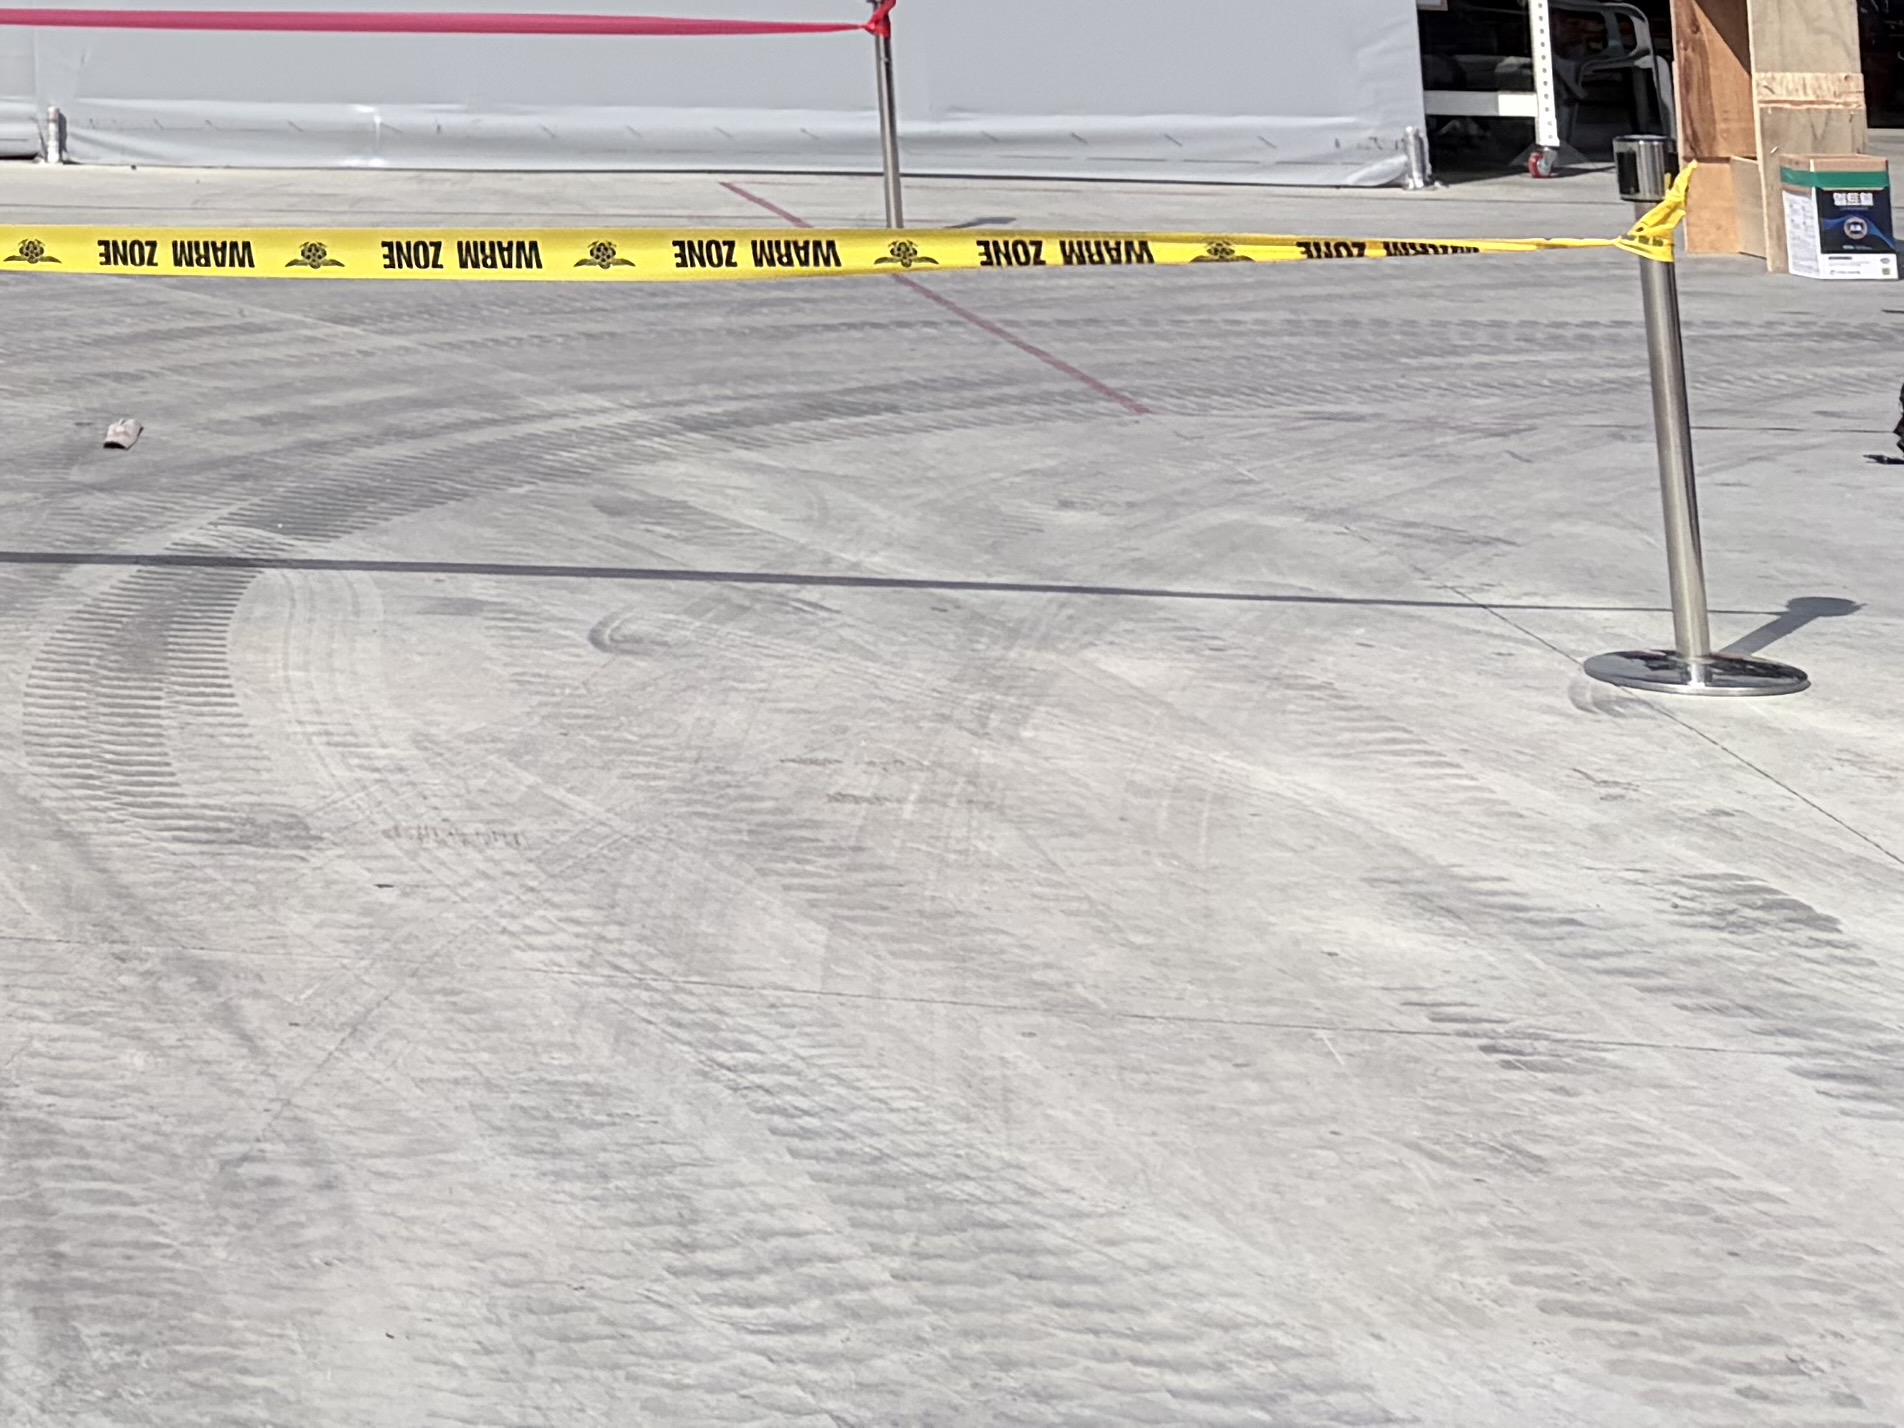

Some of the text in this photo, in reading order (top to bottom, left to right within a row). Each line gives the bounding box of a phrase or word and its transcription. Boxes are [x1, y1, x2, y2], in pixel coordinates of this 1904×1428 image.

[96, 239, 256, 269] WARM ZONE
[380, 240, 543, 270] WARM ZONE
[671, 239, 842, 269] WARM ZONE
[975, 239, 1156, 267] WARM ZONE
